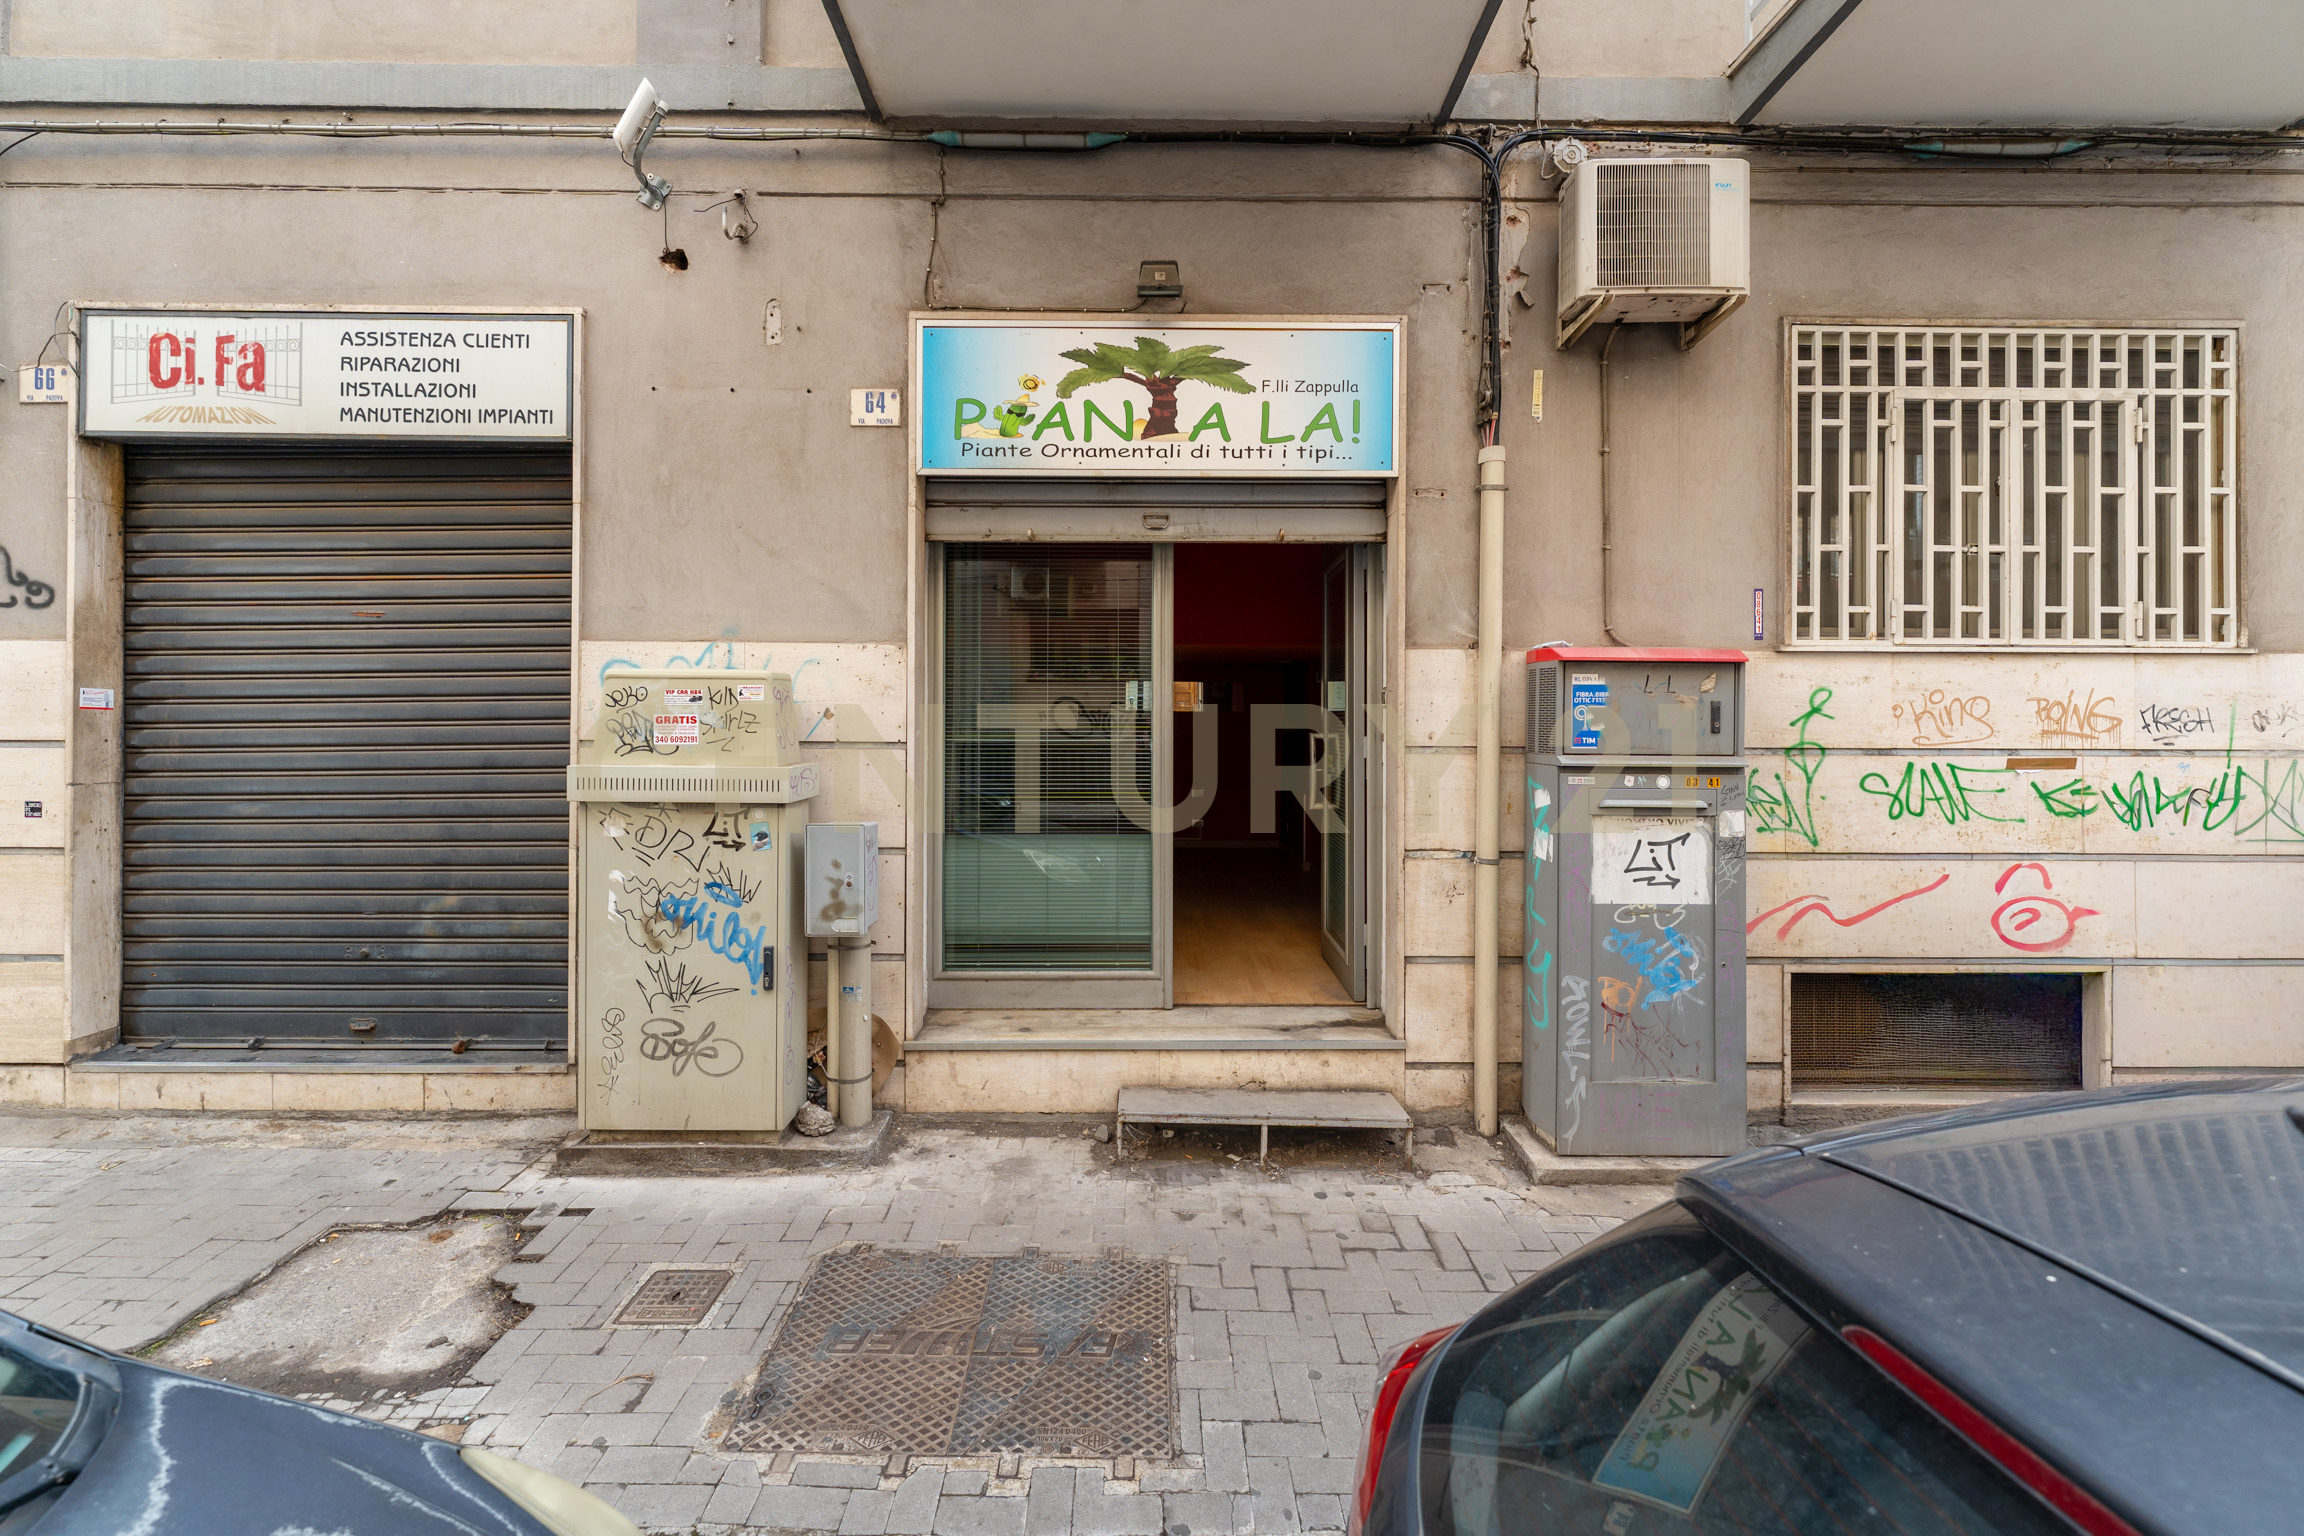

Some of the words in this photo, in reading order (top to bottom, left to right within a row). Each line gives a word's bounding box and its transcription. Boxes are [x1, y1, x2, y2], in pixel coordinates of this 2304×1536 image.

[340, 331, 457, 348] ASSISTENZA
[463, 333, 531, 349] CLIENTI
[340, 356, 460, 373] RIPARAZIONI
[34, 367, 55, 391] 66
[1261, 379, 1290, 394] F.lli
[1294, 379, 1360, 397] Zappulla
[340, 382, 477, 399] INSTALLAZIONI
[865, 391, 886, 414] 64
[135, 405, 278, 425] AUTOMAZIONI
[340, 407, 472, 424] MANUTENZIONI
[478, 408, 554, 425] IMPIANTI
[961, 442, 1033, 458] Piante
[1041, 442, 1181, 459] Ornamentali
[1190, 444, 1211, 459] di
[1219, 445, 1273, 459] tutti
[1296, 445, 1353, 464] tipi...
[655, 715, 698, 725] GRATIS
[655, 735, 669, 743] 340
[670, 735, 698, 743] 6092191
[1686, 778, 1698, 786] 03
[1708, 778, 1719, 787] 41
